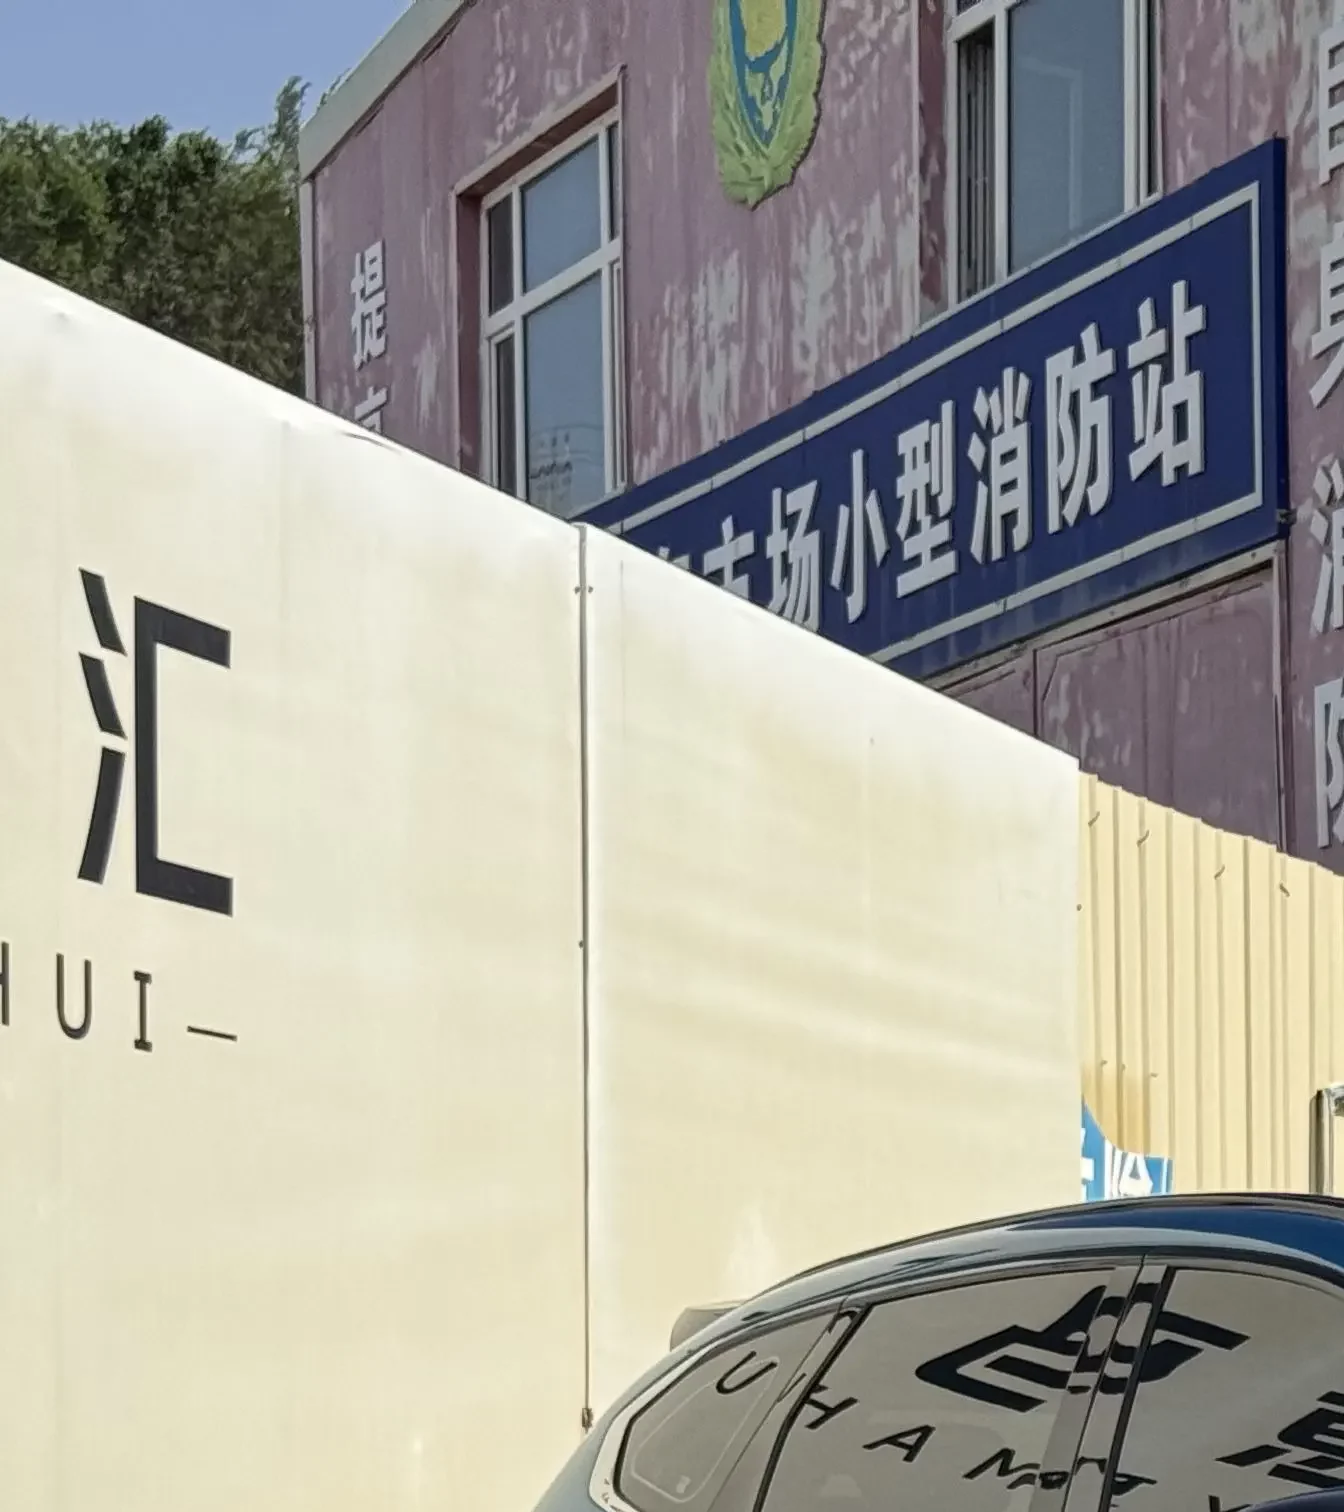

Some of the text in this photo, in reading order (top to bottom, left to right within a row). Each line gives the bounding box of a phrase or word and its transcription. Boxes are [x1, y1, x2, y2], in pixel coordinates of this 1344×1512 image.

[656, 280, 1208, 634] 市场小型消防站
[77, 567, 234, 917] 汇
